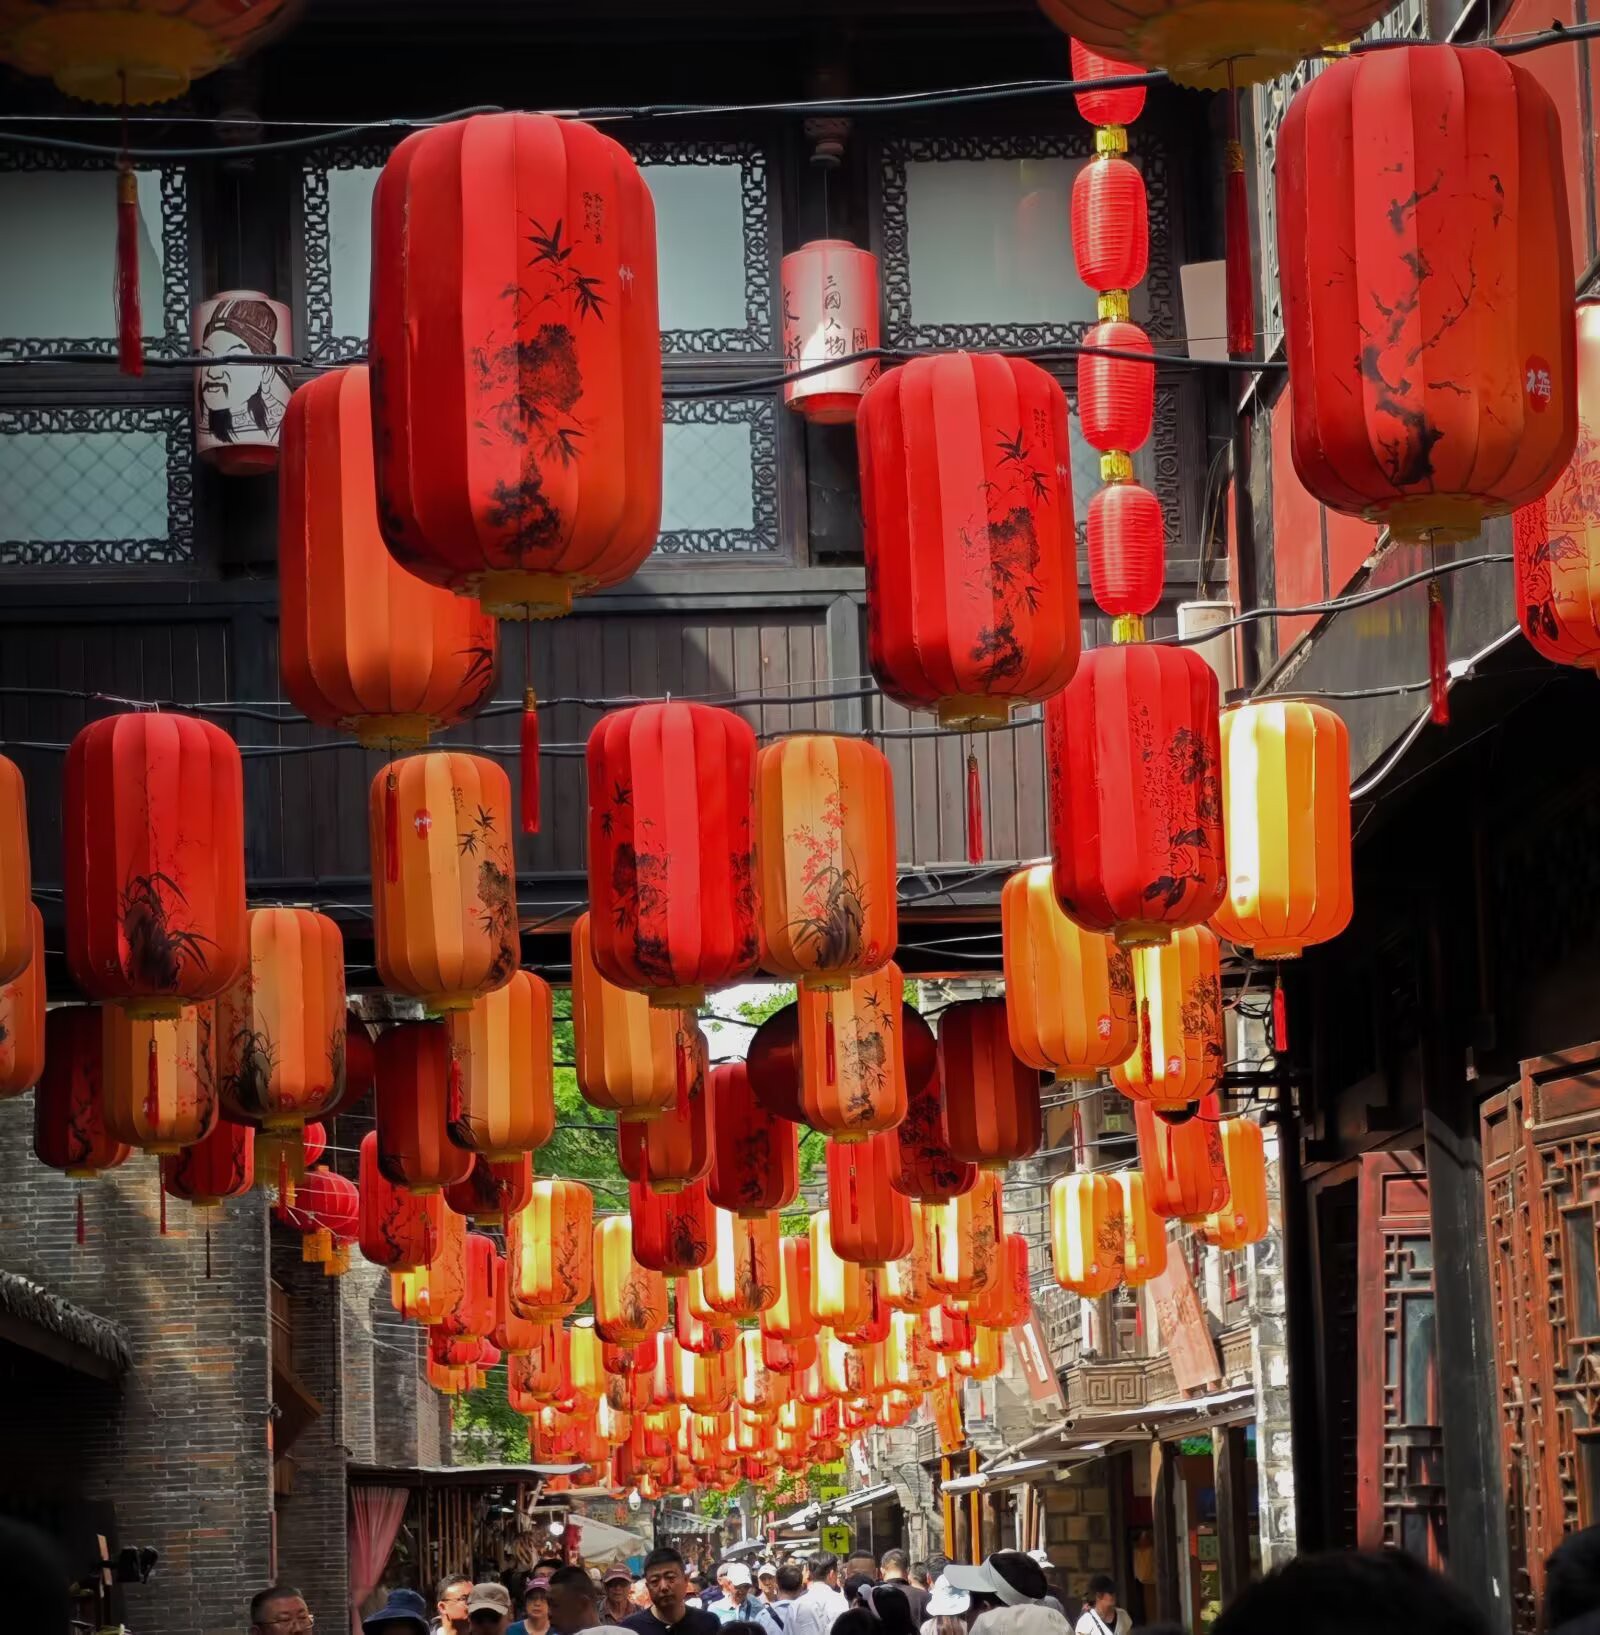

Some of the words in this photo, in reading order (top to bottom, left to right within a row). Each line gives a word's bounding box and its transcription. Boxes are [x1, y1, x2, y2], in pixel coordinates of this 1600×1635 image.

[824, 275, 847, 356] 三國人物
[1526, 369, 1552, 403] 梅
